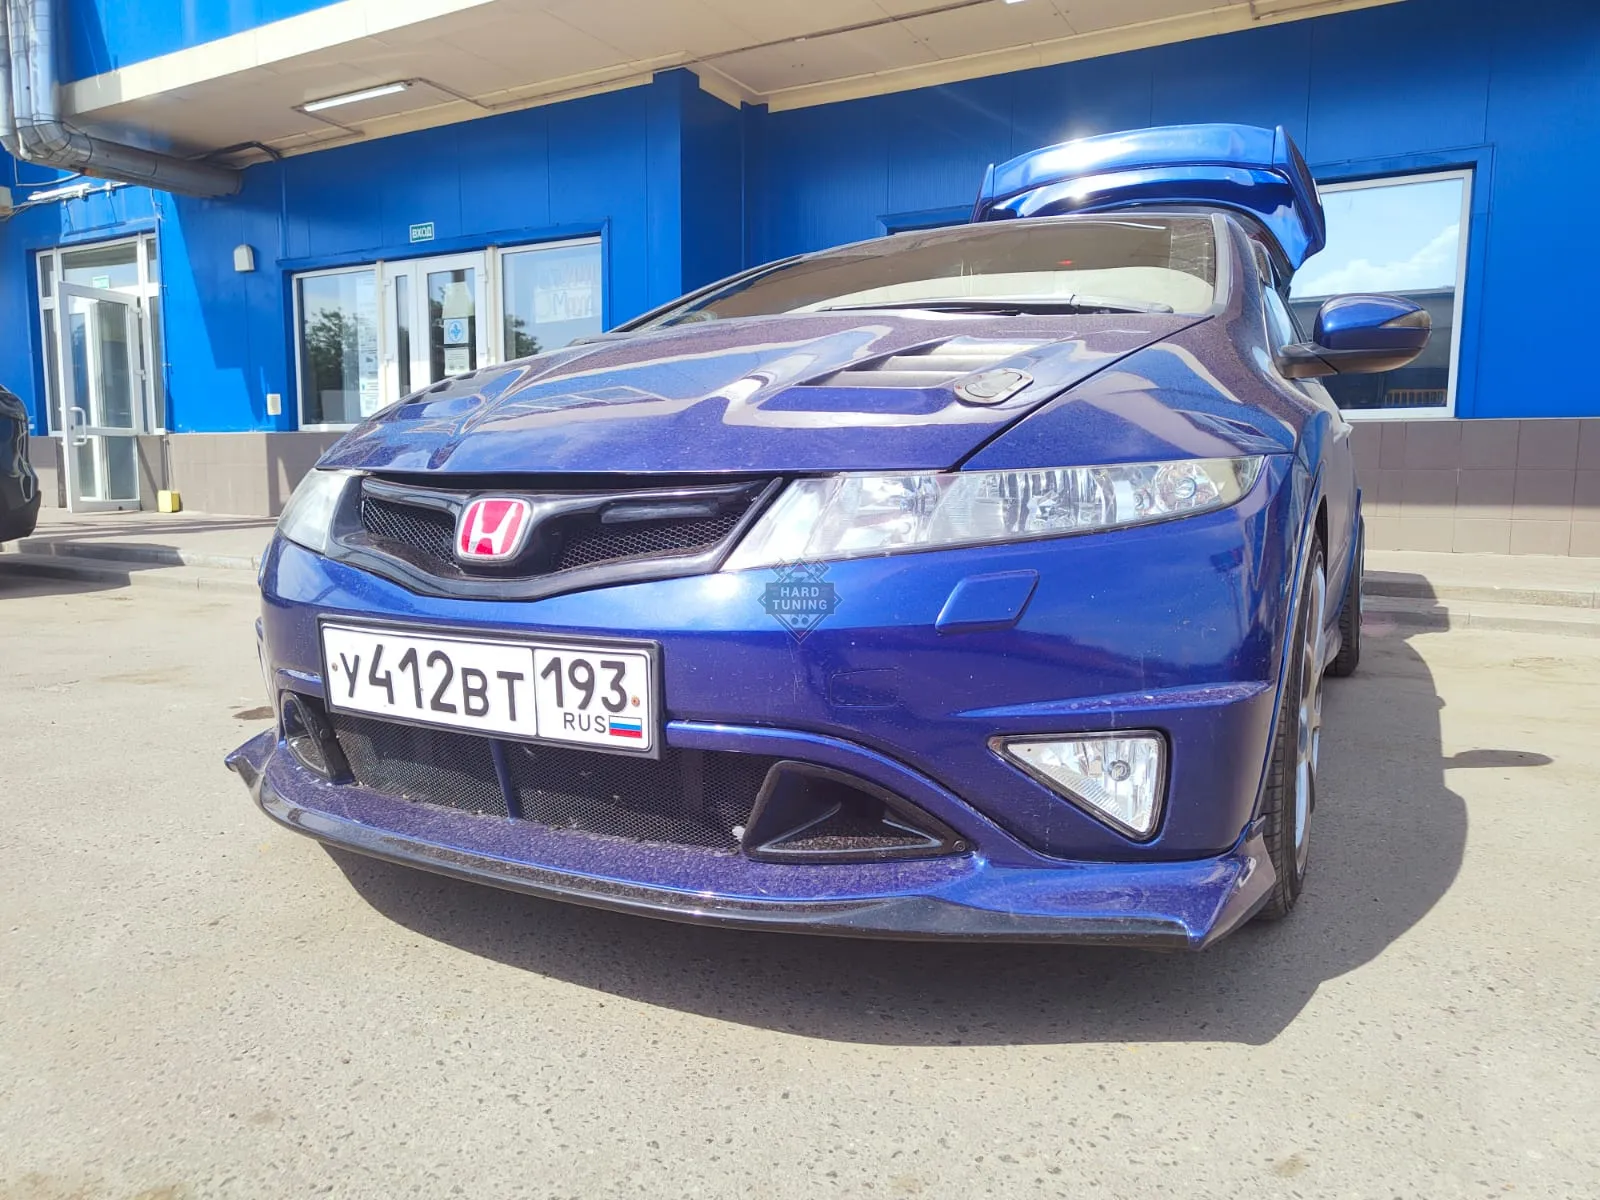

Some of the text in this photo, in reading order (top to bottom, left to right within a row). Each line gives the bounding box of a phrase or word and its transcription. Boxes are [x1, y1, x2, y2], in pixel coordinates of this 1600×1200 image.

[412, 226, 433, 239] ВХОД
[540, 656, 629, 713] 193
[563, 712, 607, 734] RUS
